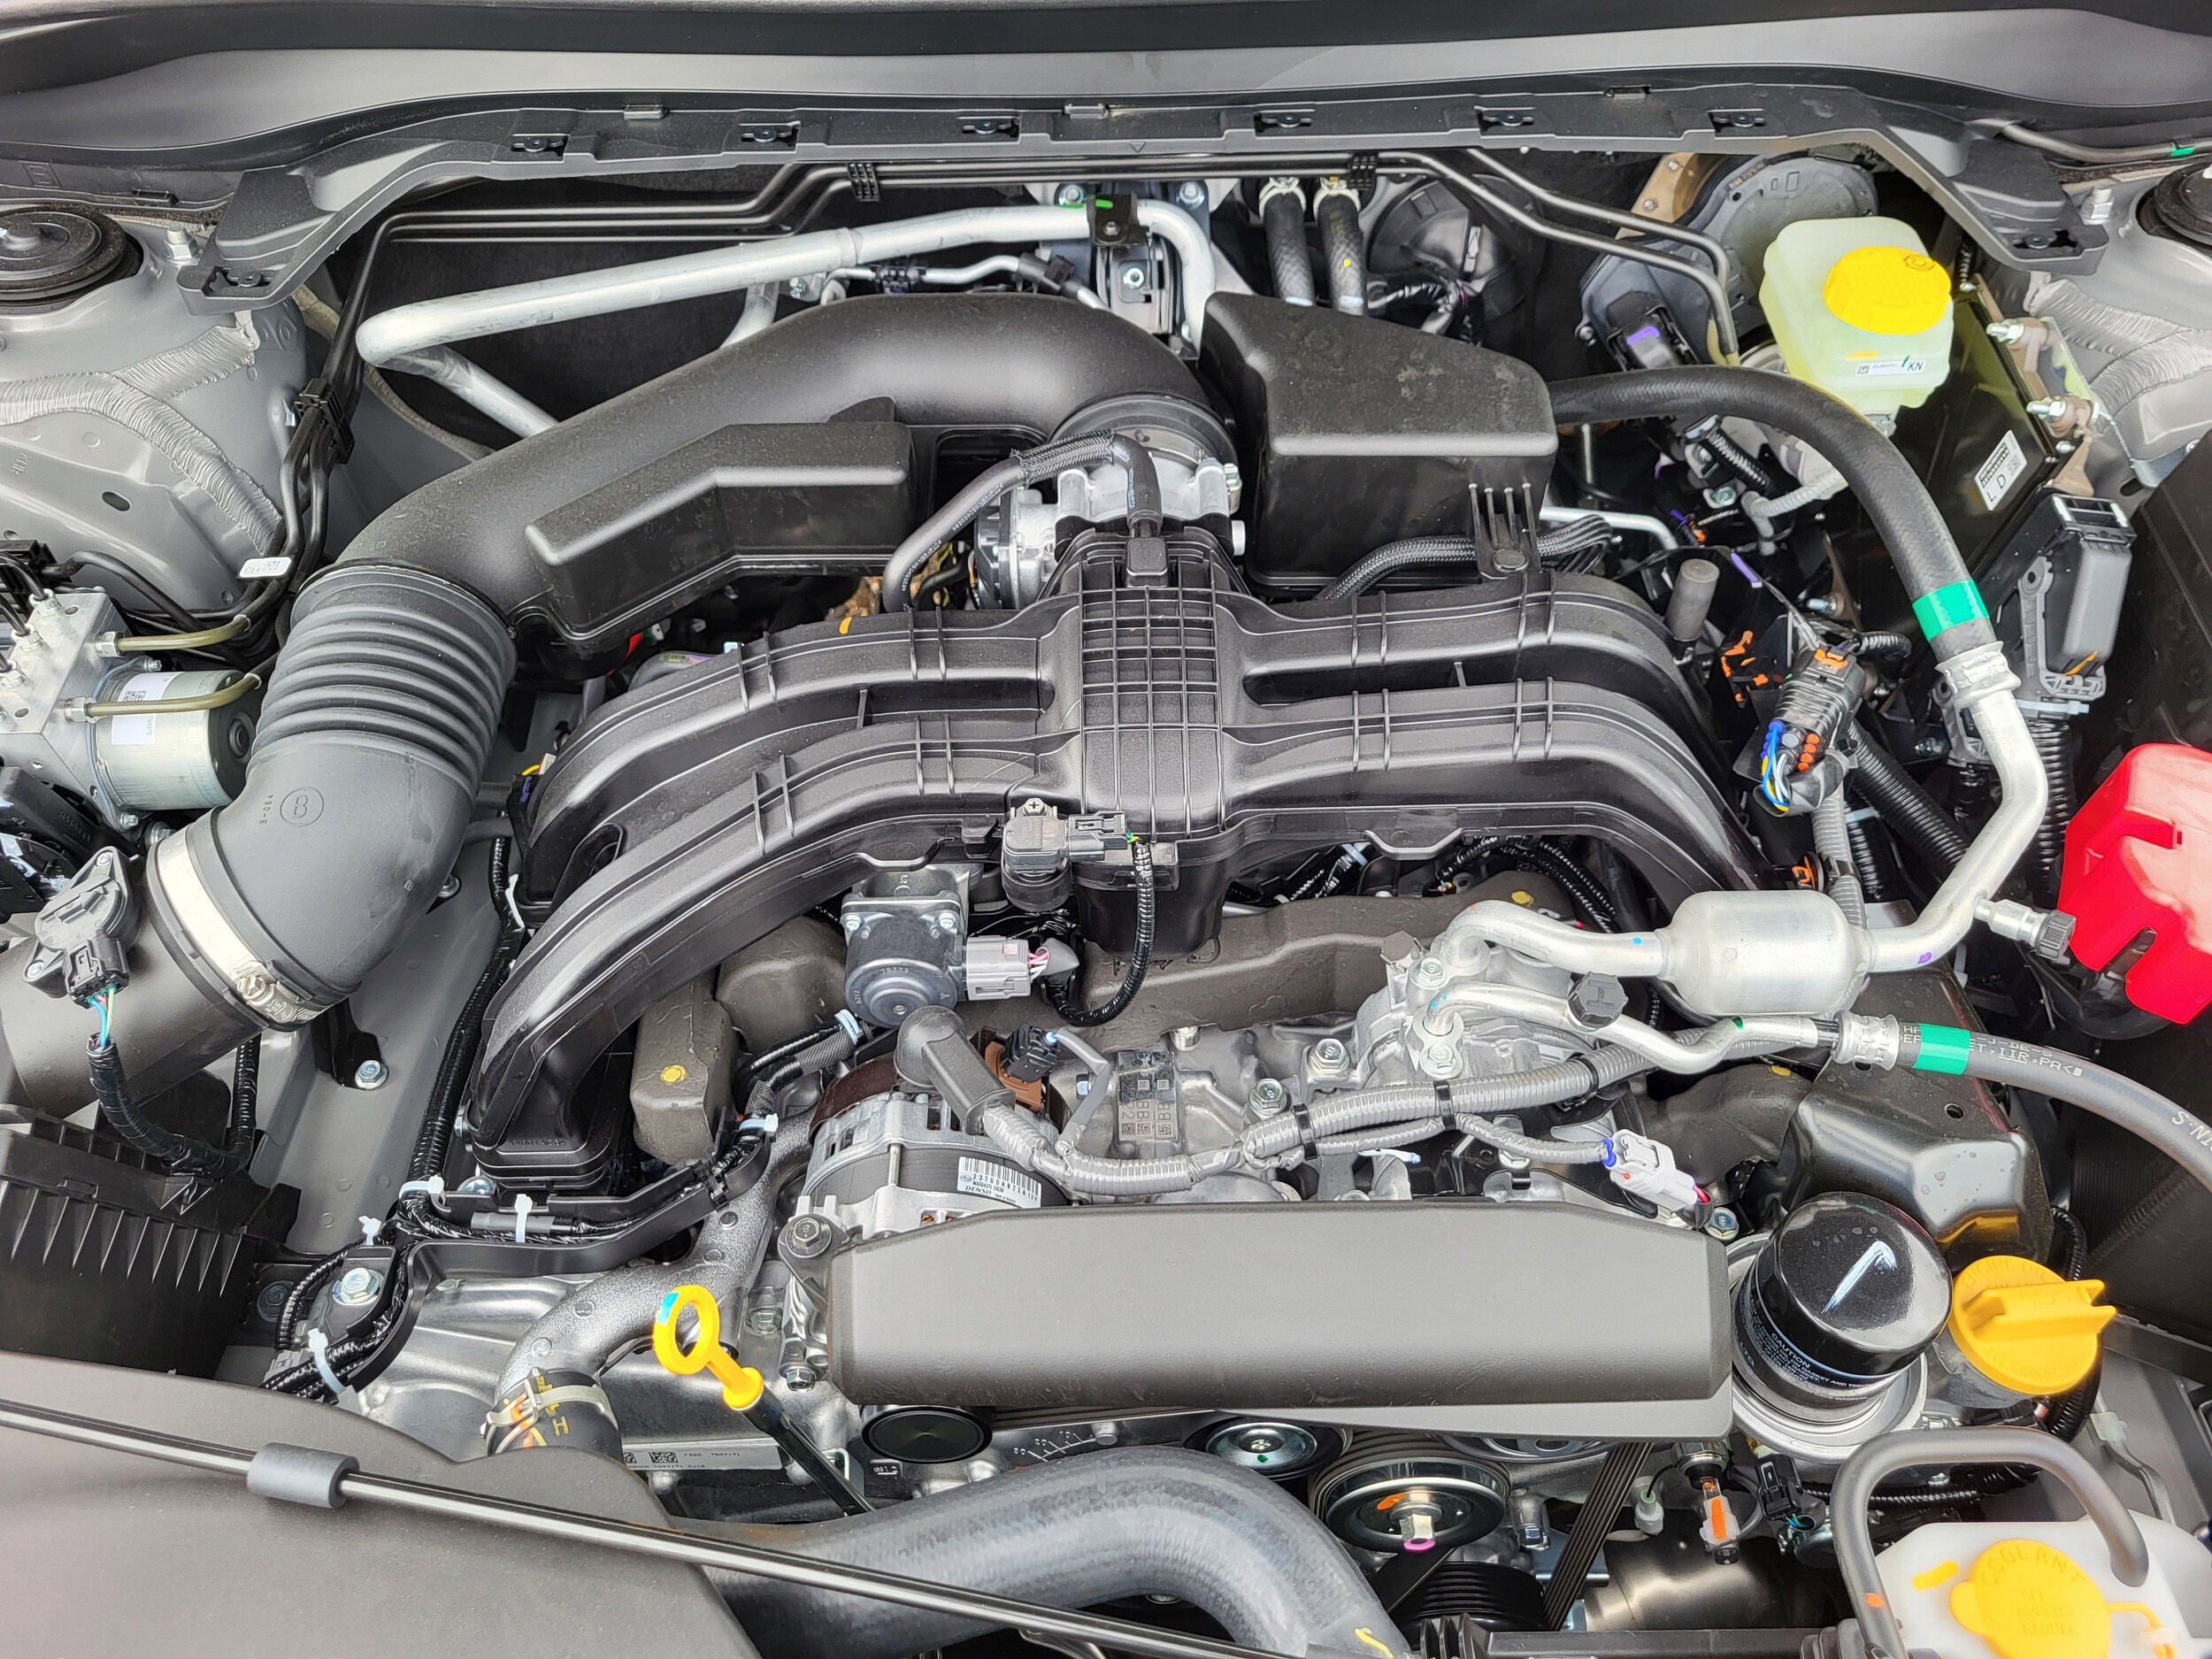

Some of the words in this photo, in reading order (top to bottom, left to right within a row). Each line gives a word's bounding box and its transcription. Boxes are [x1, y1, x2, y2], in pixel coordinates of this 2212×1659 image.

[1907, 361, 1924, 372] KN
[1996, 474, 2007, 489] D
[294, 794, 309, 818] B
[965, 1186, 992, 1195] DENSO
[1770, 1332, 1811, 1369] CAUTION
[1801, 1365, 1831, 1382] GASKET
[1980, 1544, 2086, 1589] COOLANT
